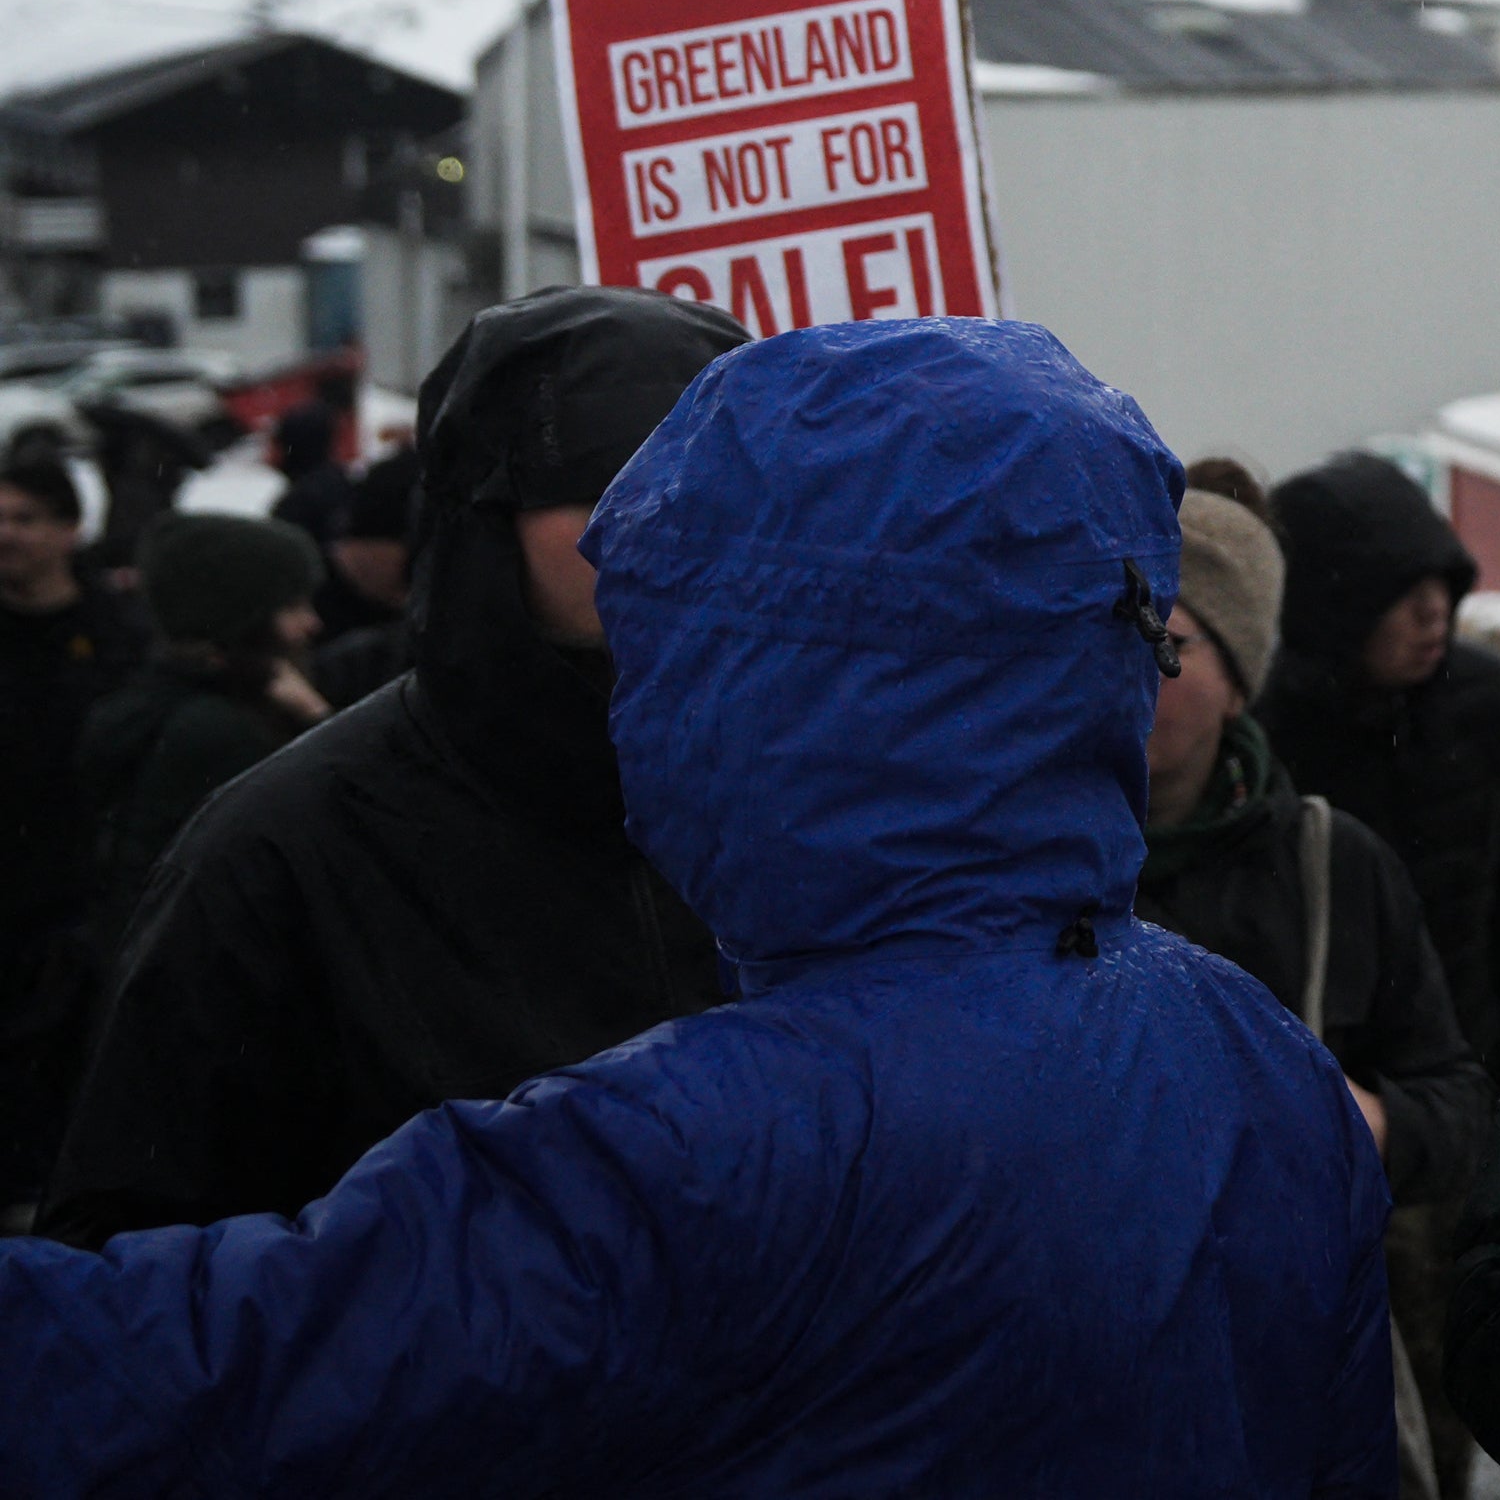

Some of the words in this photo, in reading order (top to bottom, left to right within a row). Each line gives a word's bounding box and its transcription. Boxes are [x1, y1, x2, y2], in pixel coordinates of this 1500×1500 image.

[622, 8, 901, 115] GREENLAND
[635, 157, 681, 224] IS
[702, 136, 792, 211] NOT
[820, 117, 914, 191] FOR
[655, 227, 935, 337] ALE!
